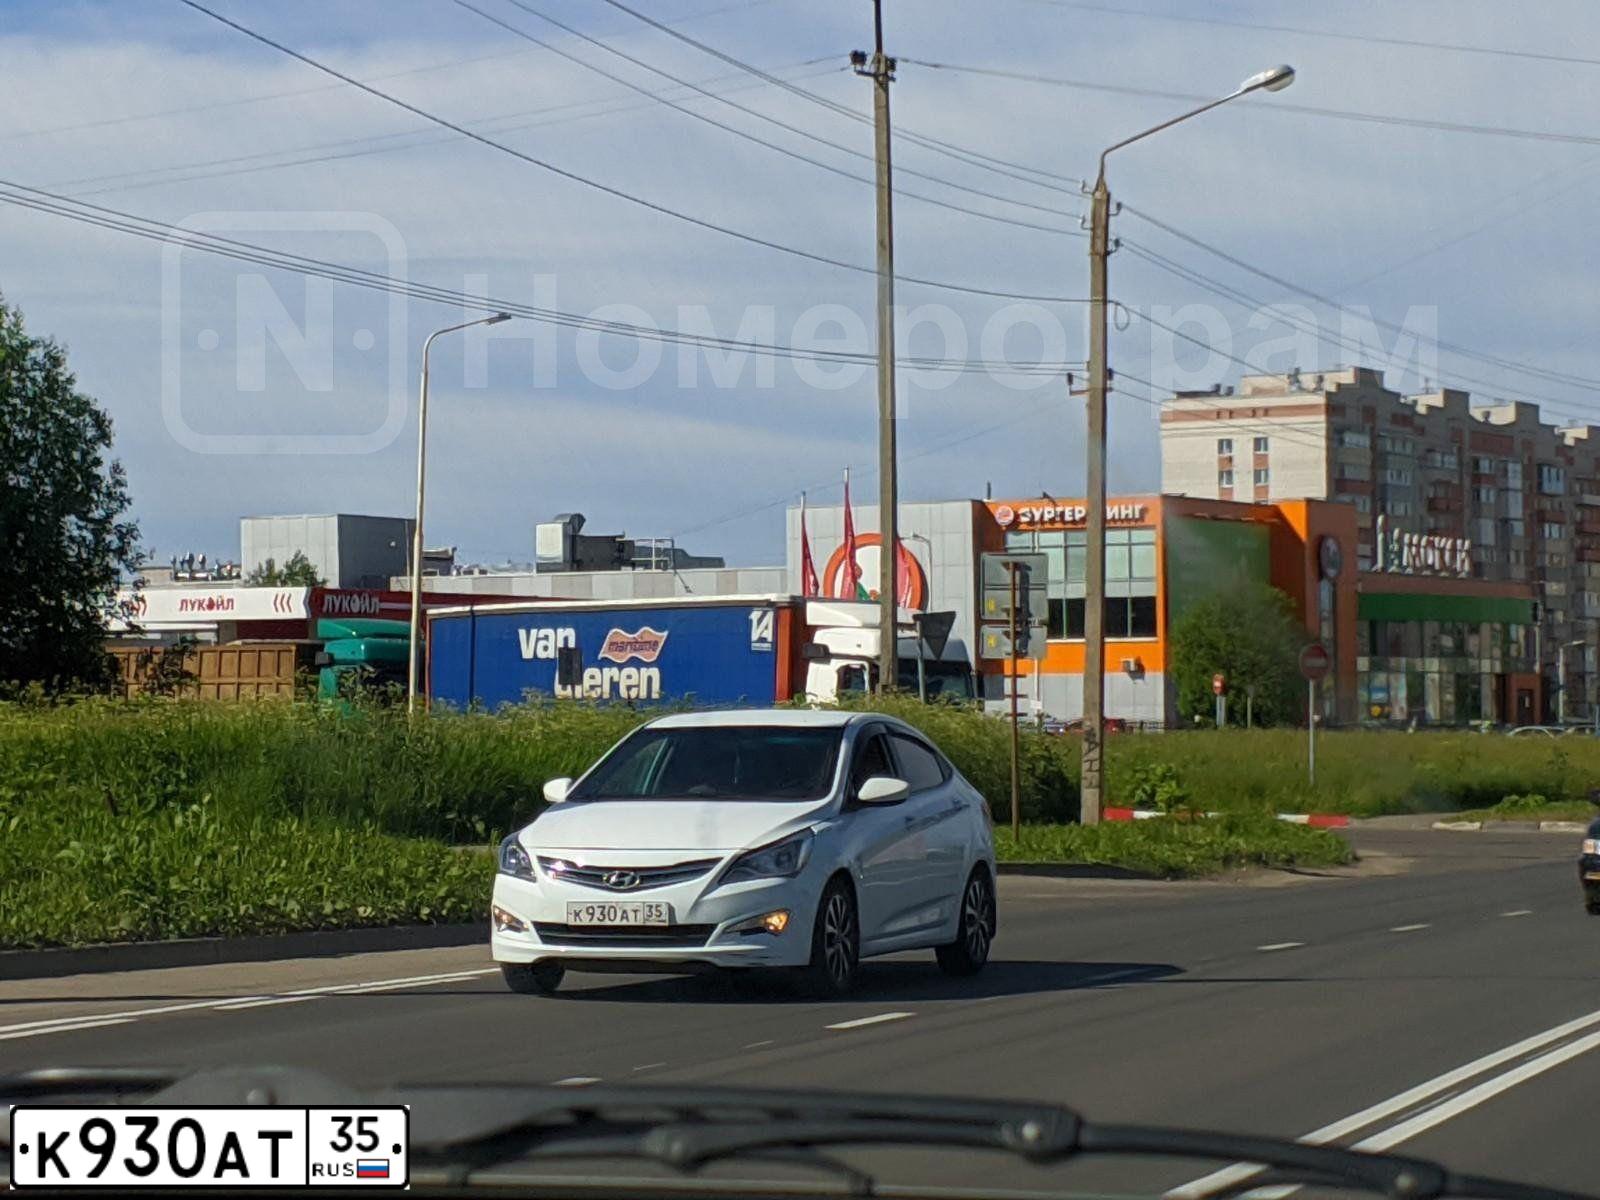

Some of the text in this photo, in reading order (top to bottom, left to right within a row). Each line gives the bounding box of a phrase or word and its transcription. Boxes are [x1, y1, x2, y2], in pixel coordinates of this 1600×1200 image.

[1106, 503, 1143, 520] ИНГ
[179, 597, 234, 612] ЛУКОЙЛ
[518, 626, 576, 659] van
[646, 904, 663, 918] 35
